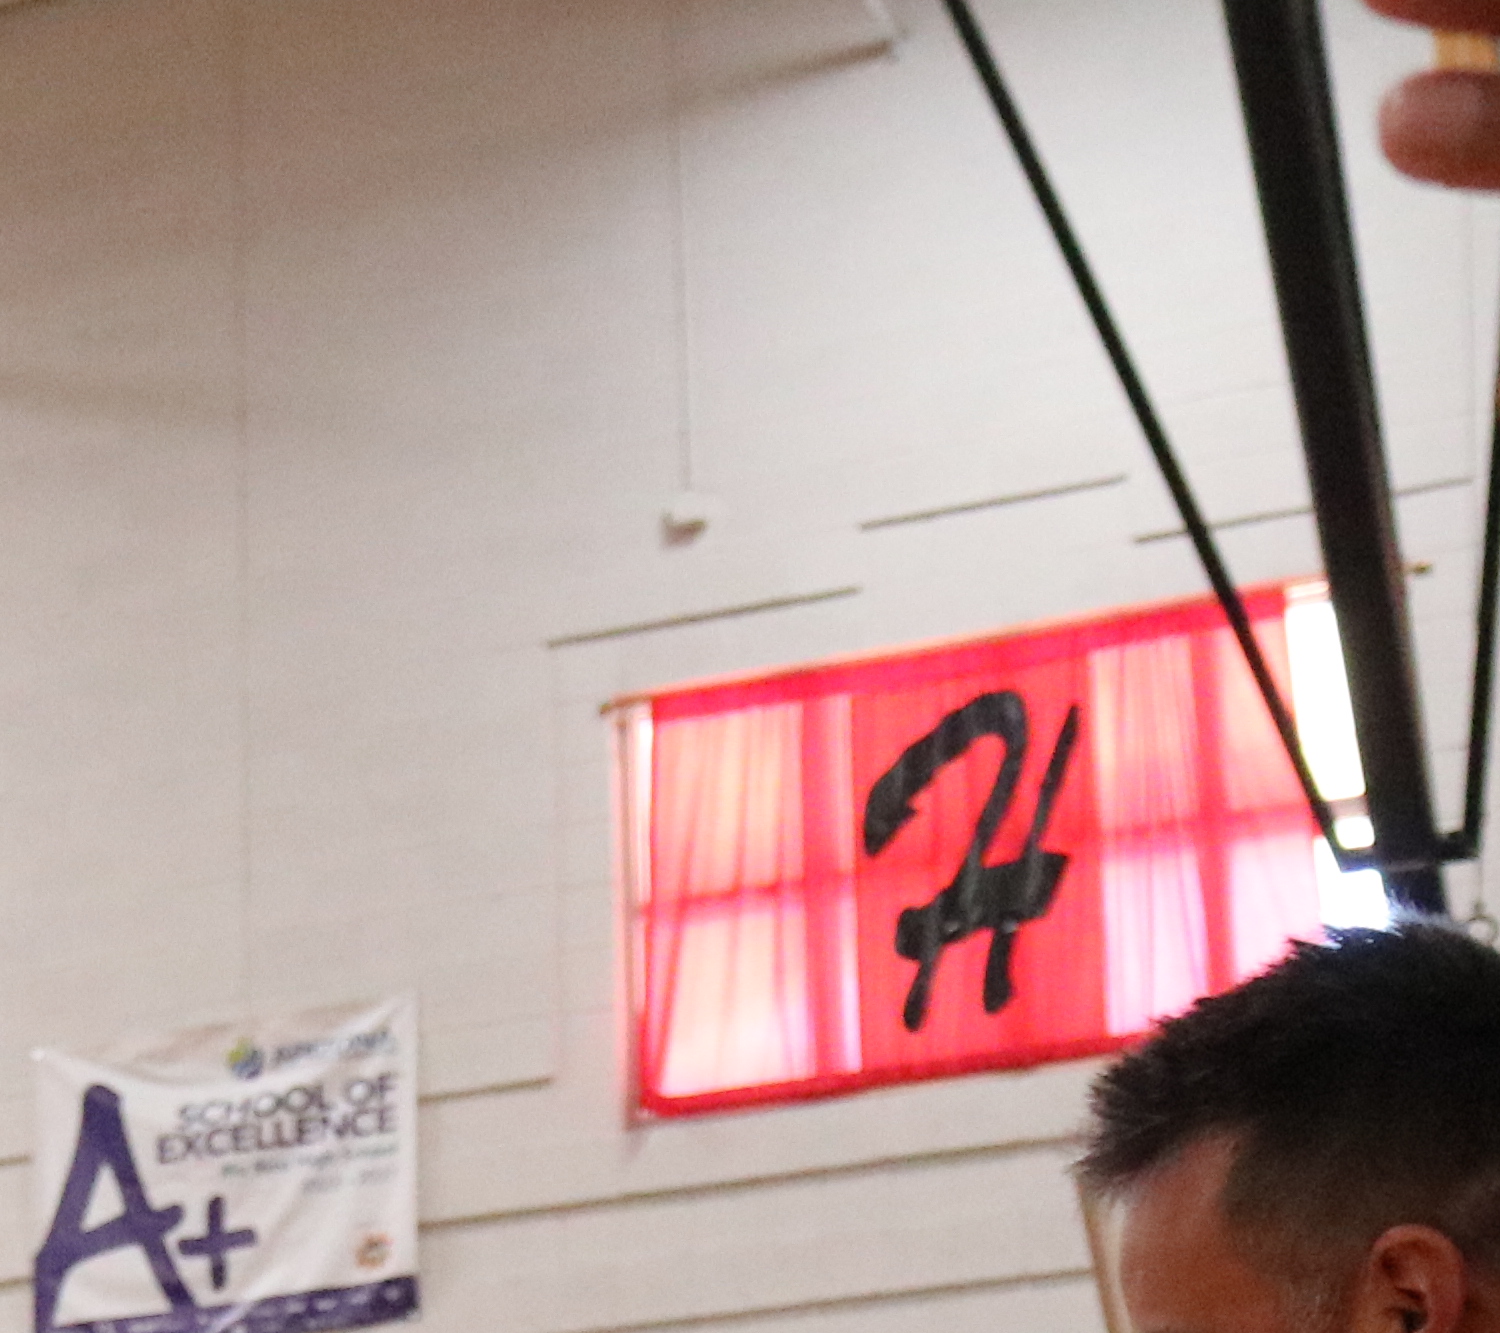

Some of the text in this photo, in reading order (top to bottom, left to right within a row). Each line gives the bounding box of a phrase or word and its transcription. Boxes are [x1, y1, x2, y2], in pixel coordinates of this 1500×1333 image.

[180, 1072, 398, 1126] SCHOOL OF
[157, 1107, 398, 1163] EXCELLENCE
